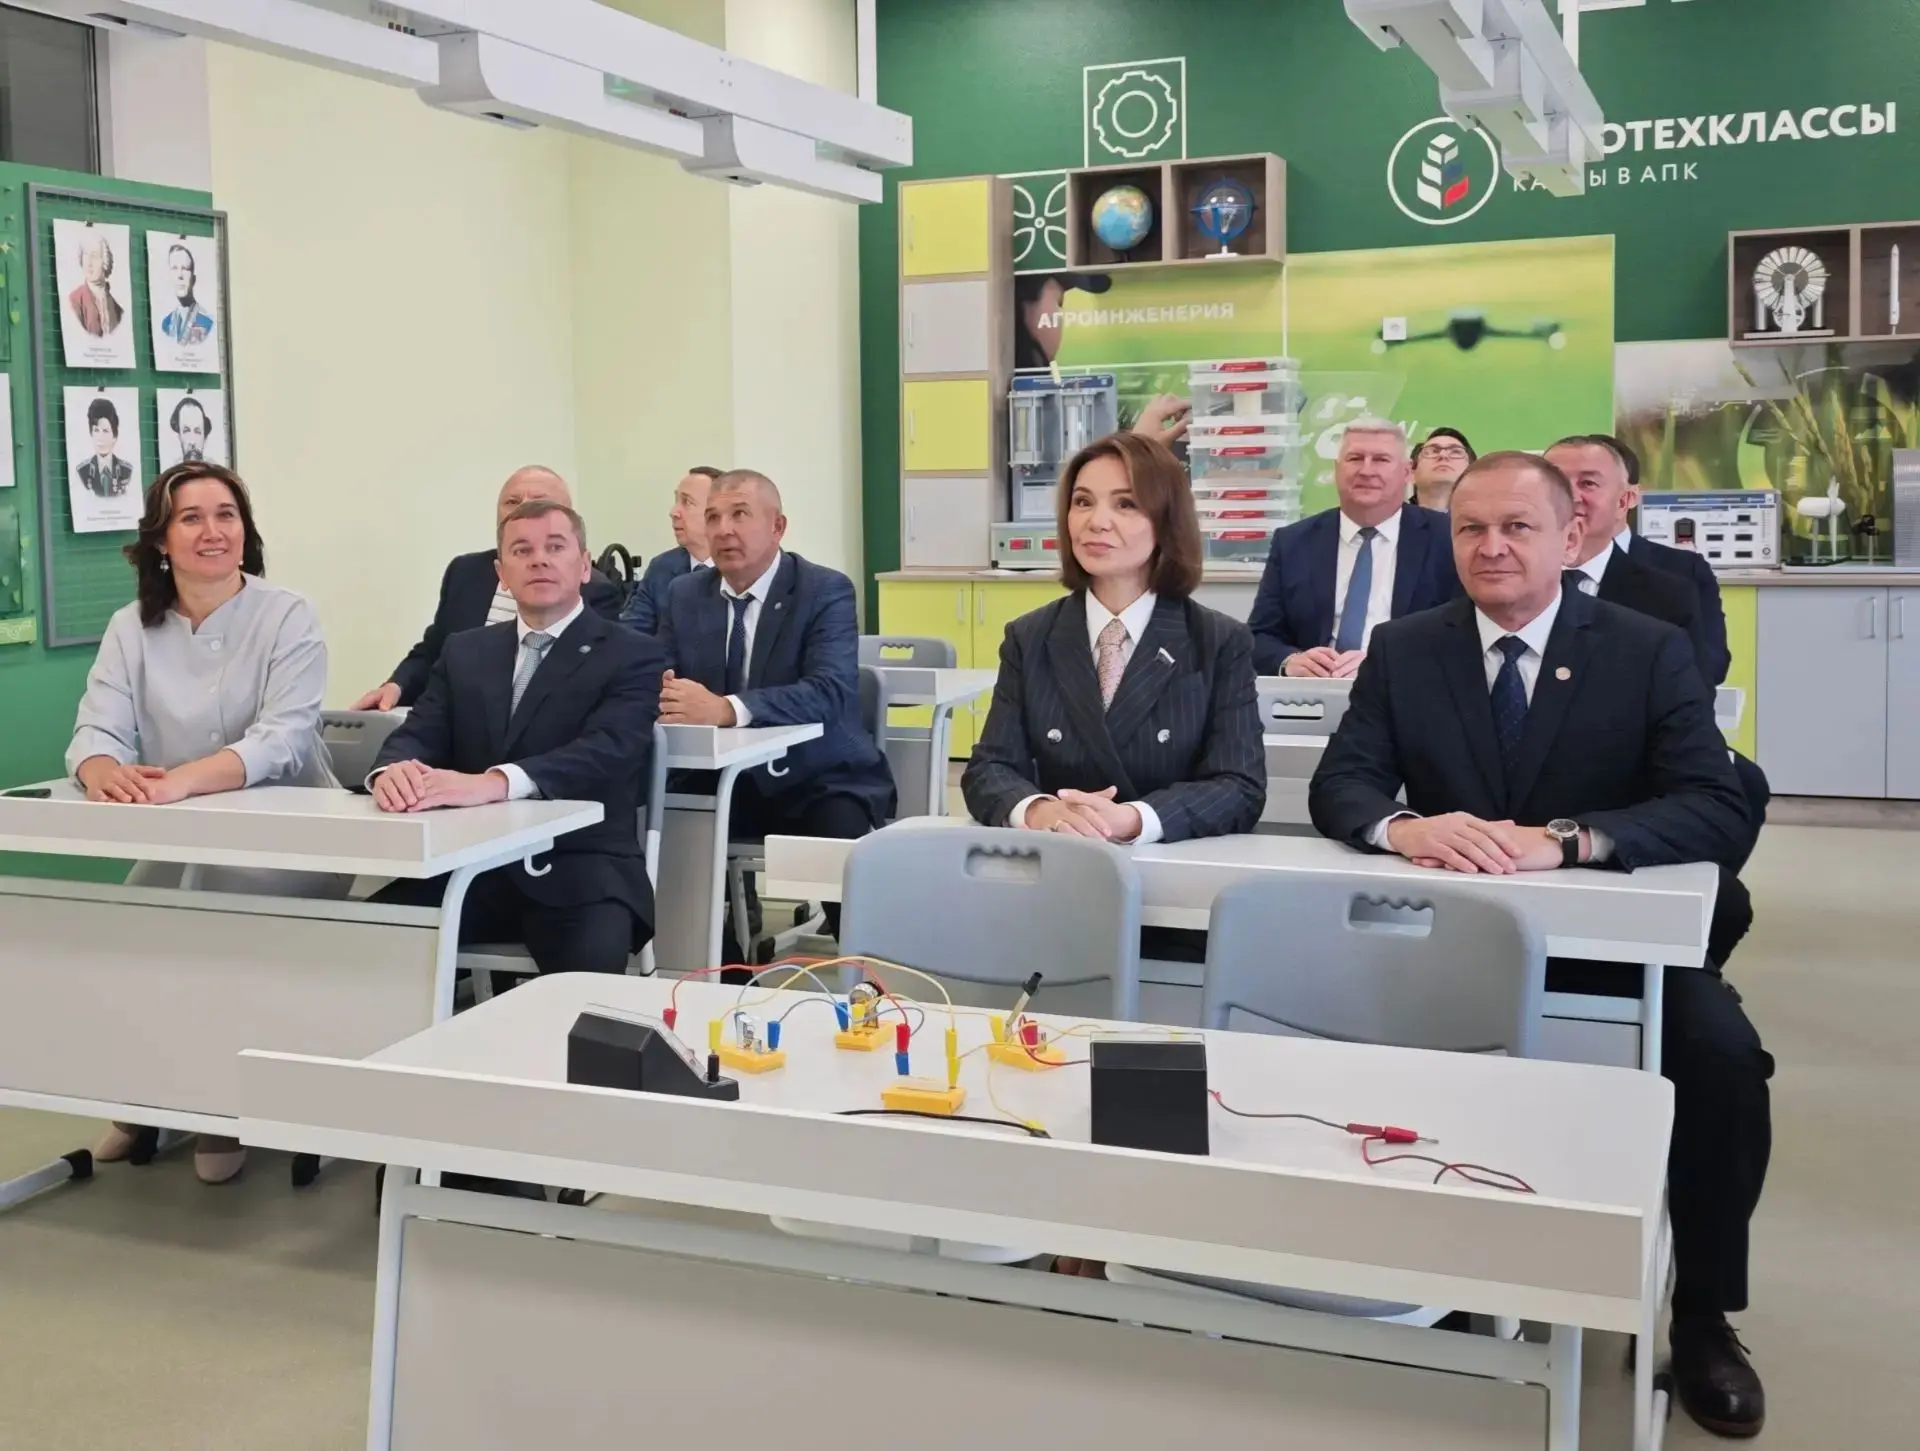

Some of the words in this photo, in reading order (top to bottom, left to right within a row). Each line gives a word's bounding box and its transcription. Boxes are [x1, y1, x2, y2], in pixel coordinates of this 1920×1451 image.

[1601, 102, 1896, 154] ОТЕХКЛАССЫ
[1618, 167, 1631, 185] В
[1640, 162, 1698, 183] АПК
[1037, 302, 1235, 329] АГРОИНЖЕНЕРИЯ
